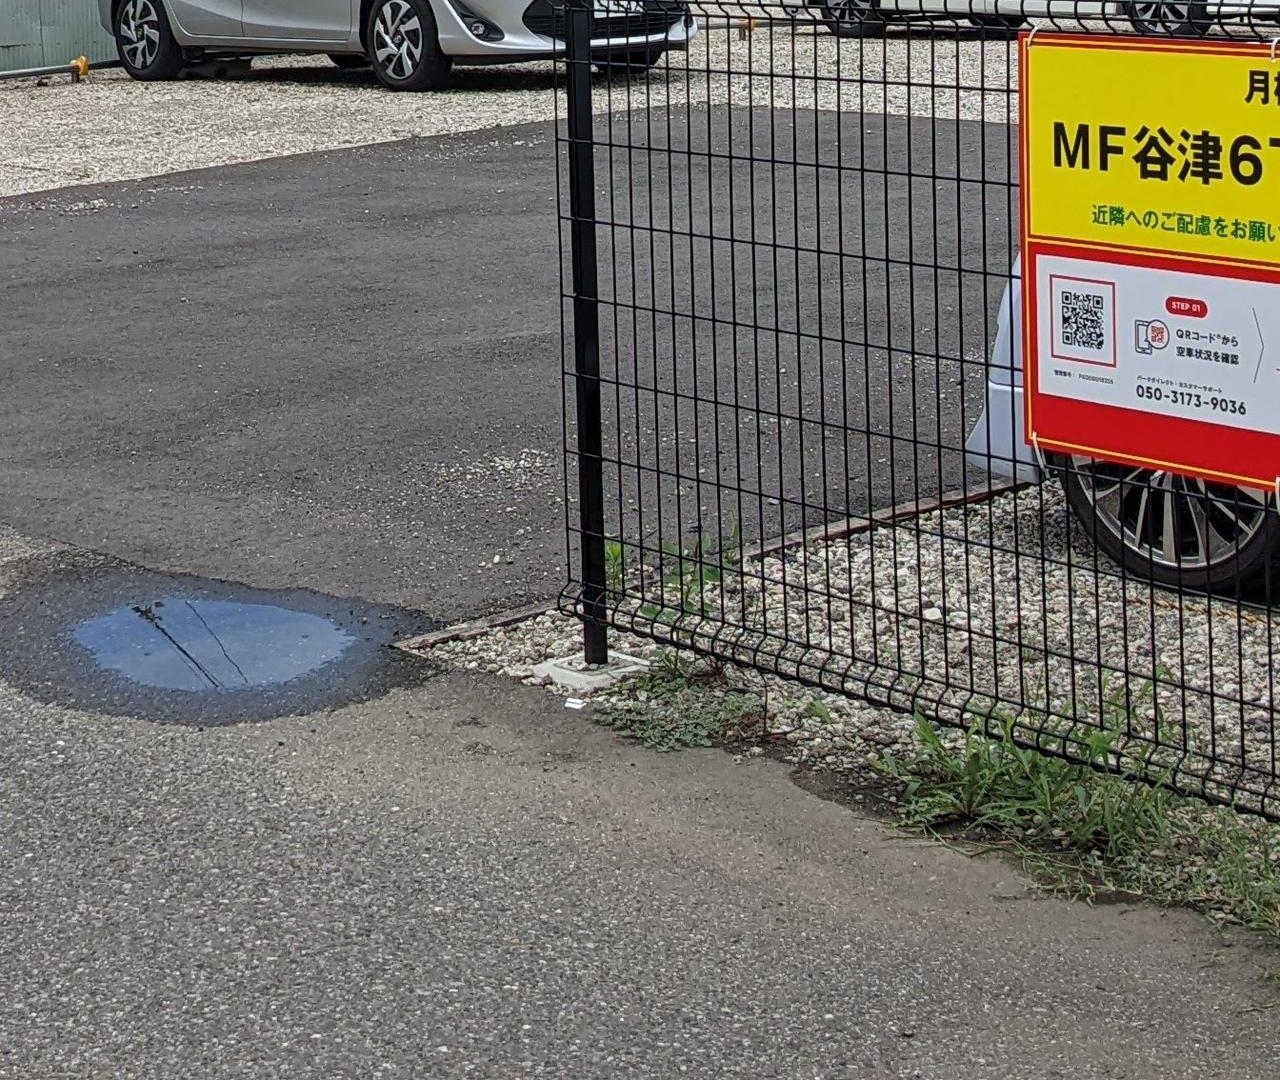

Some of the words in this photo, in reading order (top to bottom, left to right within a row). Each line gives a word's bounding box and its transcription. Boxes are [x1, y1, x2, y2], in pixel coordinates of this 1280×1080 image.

[1171, 300, 1190, 311] STEP
[1191, 303, 1201, 313] 01
[1176, 346, 1240, 366] 空車状況を確認
[1136, 384, 1247, 416] 050-3173-9036
